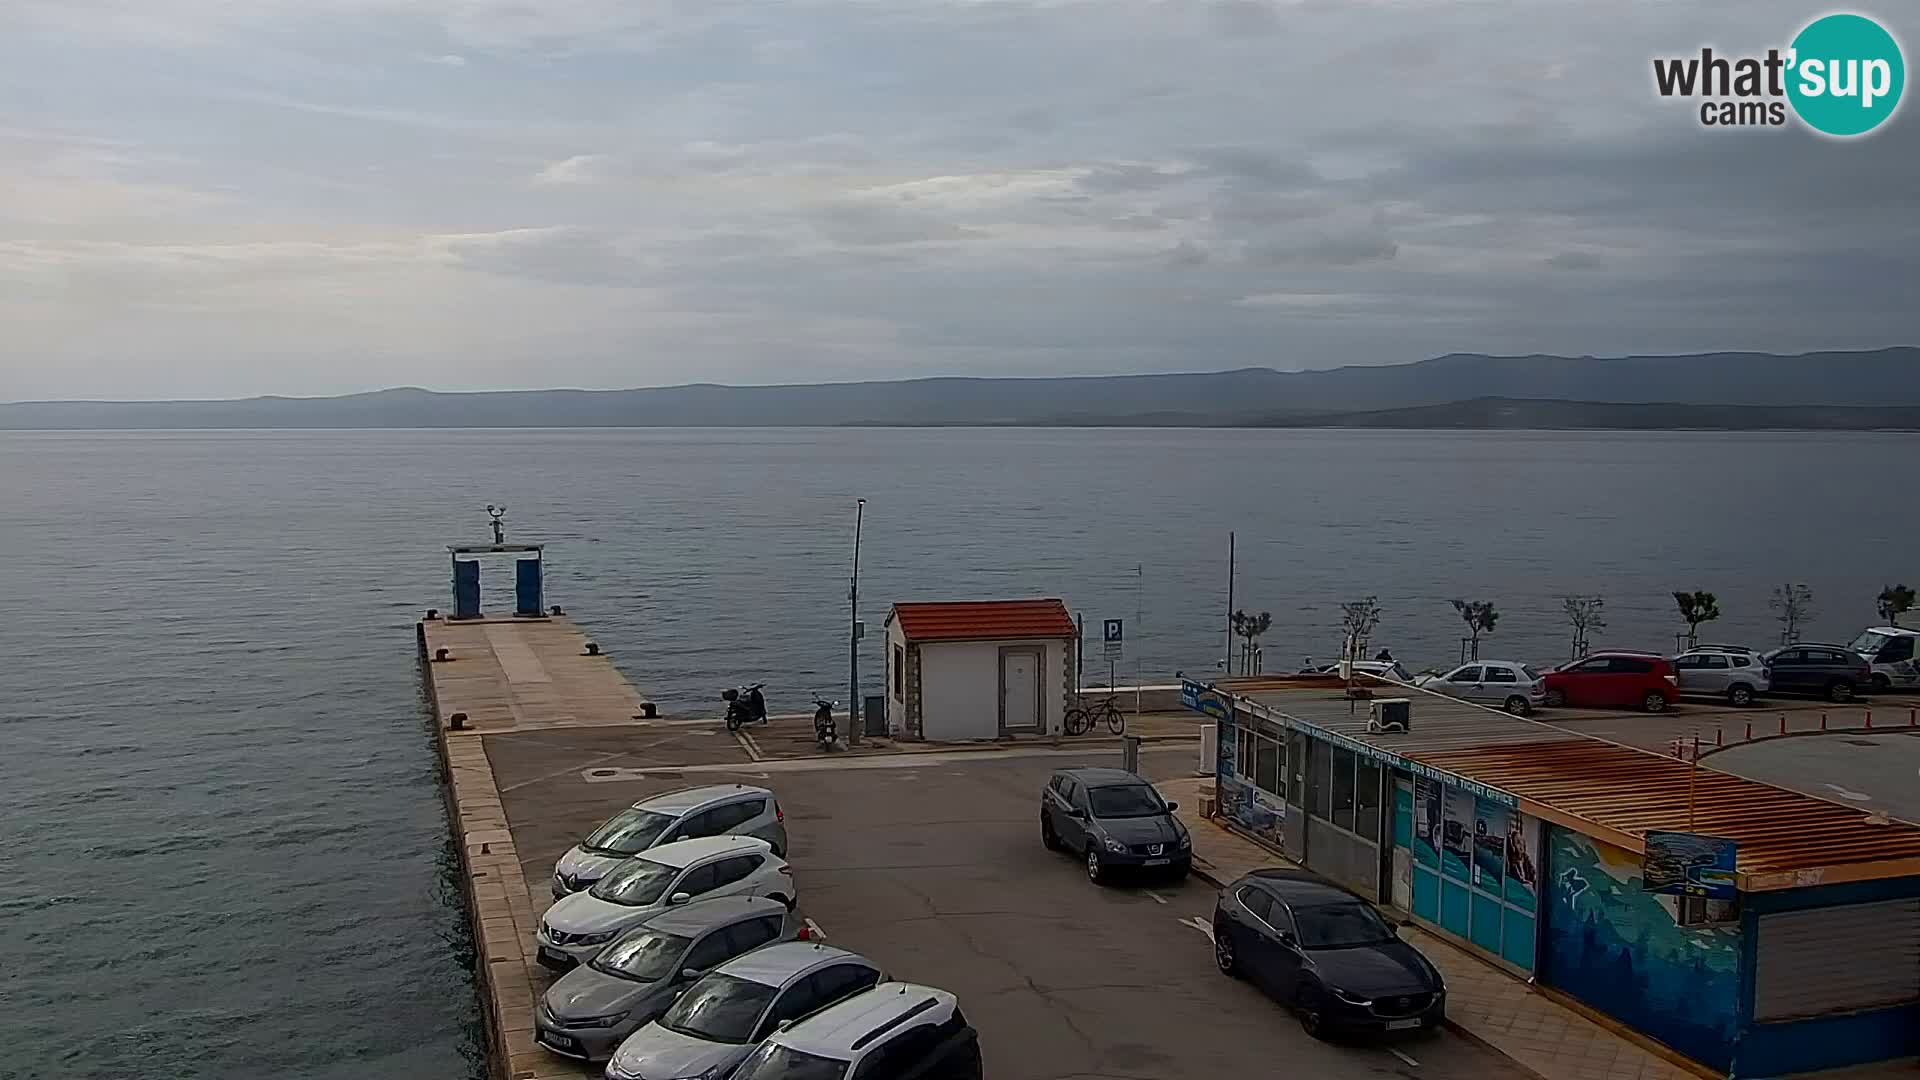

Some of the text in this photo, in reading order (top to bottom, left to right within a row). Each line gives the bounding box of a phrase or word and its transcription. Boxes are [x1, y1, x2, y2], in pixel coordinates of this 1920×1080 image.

[1108, 622, 1119, 639] P
[1410, 762, 1425, 774] BUS
[1425, 768, 1457, 785] STATION
[1459, 779, 1485, 795] TICKET
[1486, 788, 1514, 806] OFFICE
